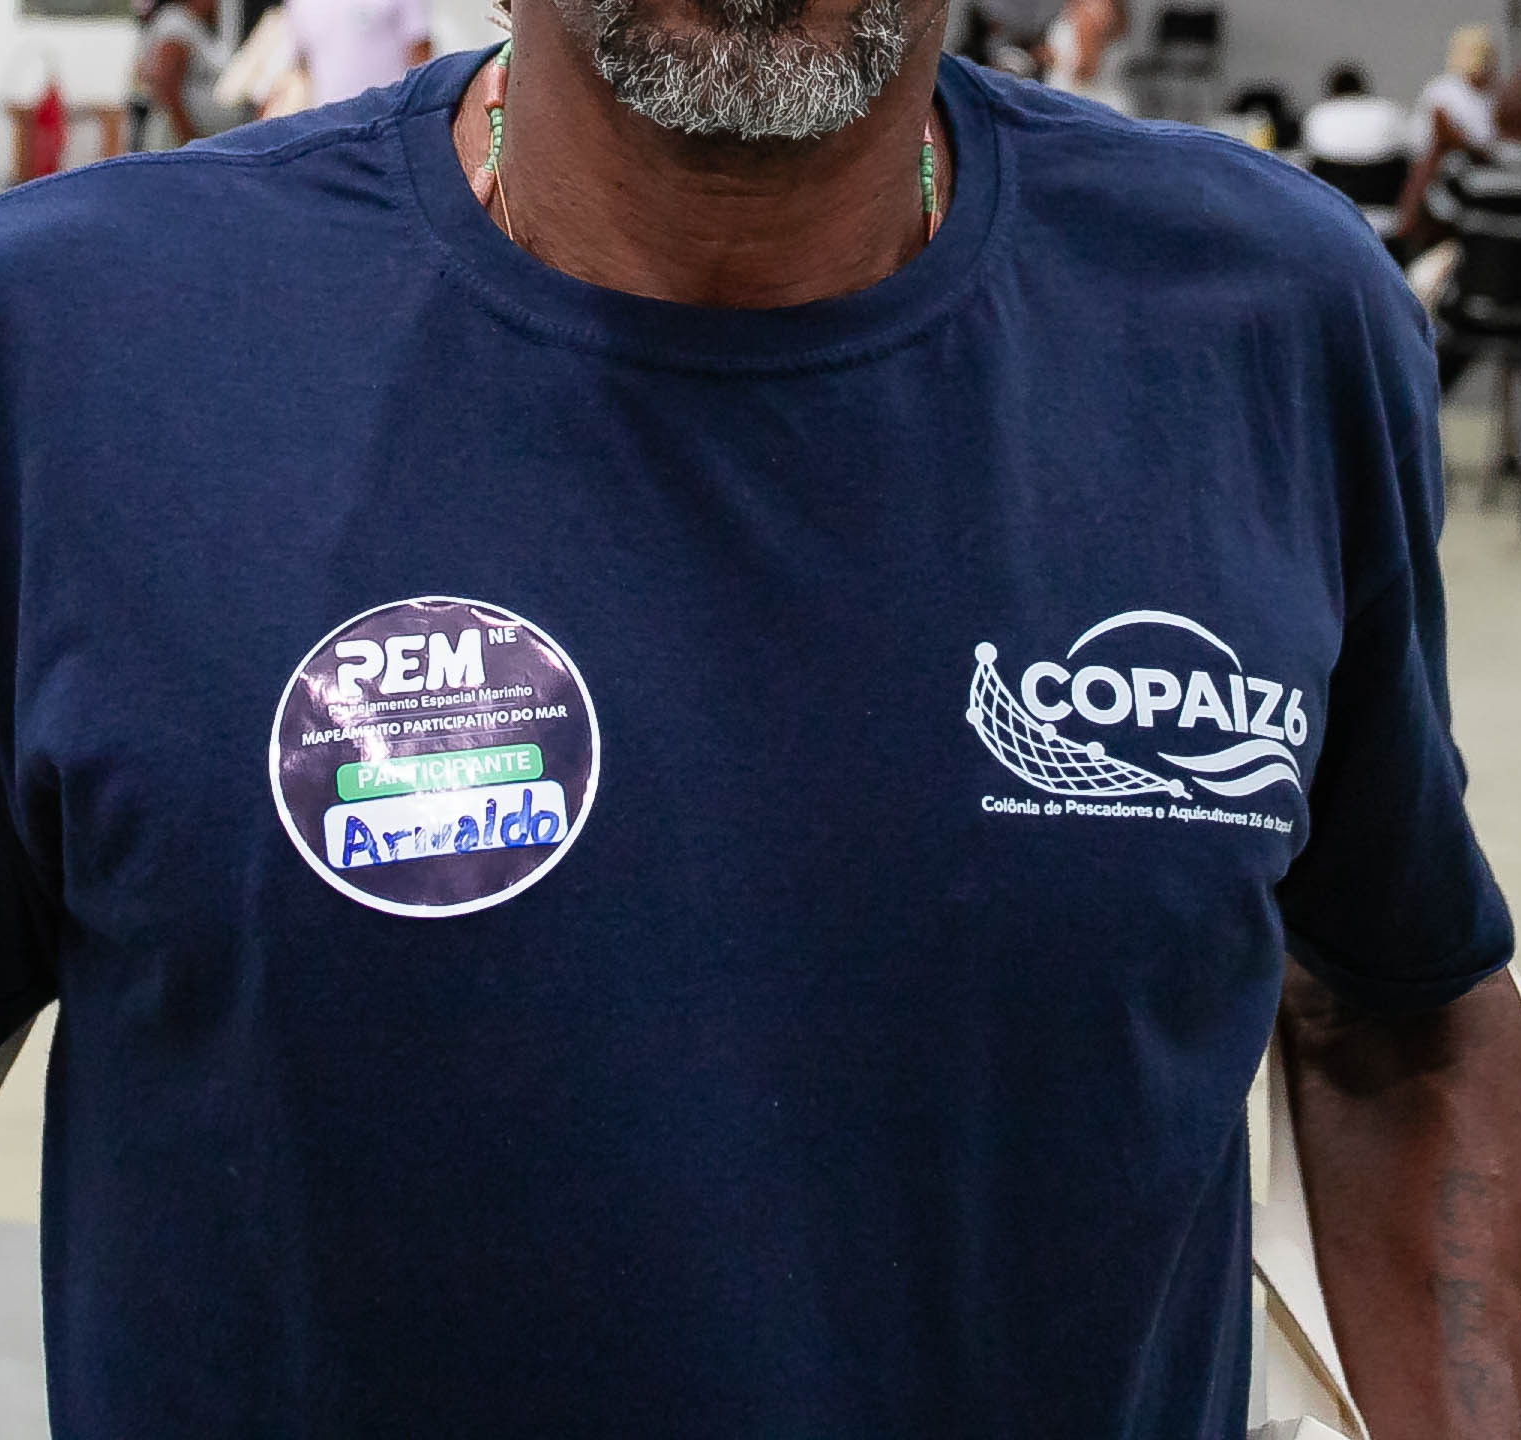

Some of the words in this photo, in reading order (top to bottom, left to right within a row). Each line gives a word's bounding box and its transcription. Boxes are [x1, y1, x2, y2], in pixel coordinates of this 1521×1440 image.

[488, 627, 518, 645] NE
[421, 690, 476, 708] Espacial
[478, 685, 533, 701] Marinho
[301, 722, 401, 746] MAPEAMENTO
[403, 710, 509, 734] PARTICIPATIVO
[511, 707, 534, 722] DO
[535, 704, 568, 720] MAR
[981, 795, 1040, 816] Colônia
[1044, 800, 1063, 816] de
[1065, 800, 1153, 818] Pescadores
[1155, 806, 1165, 819] e
[1168, 804, 1247, 826] Aquicultores
[1248, 812, 1263, 828] Z6
